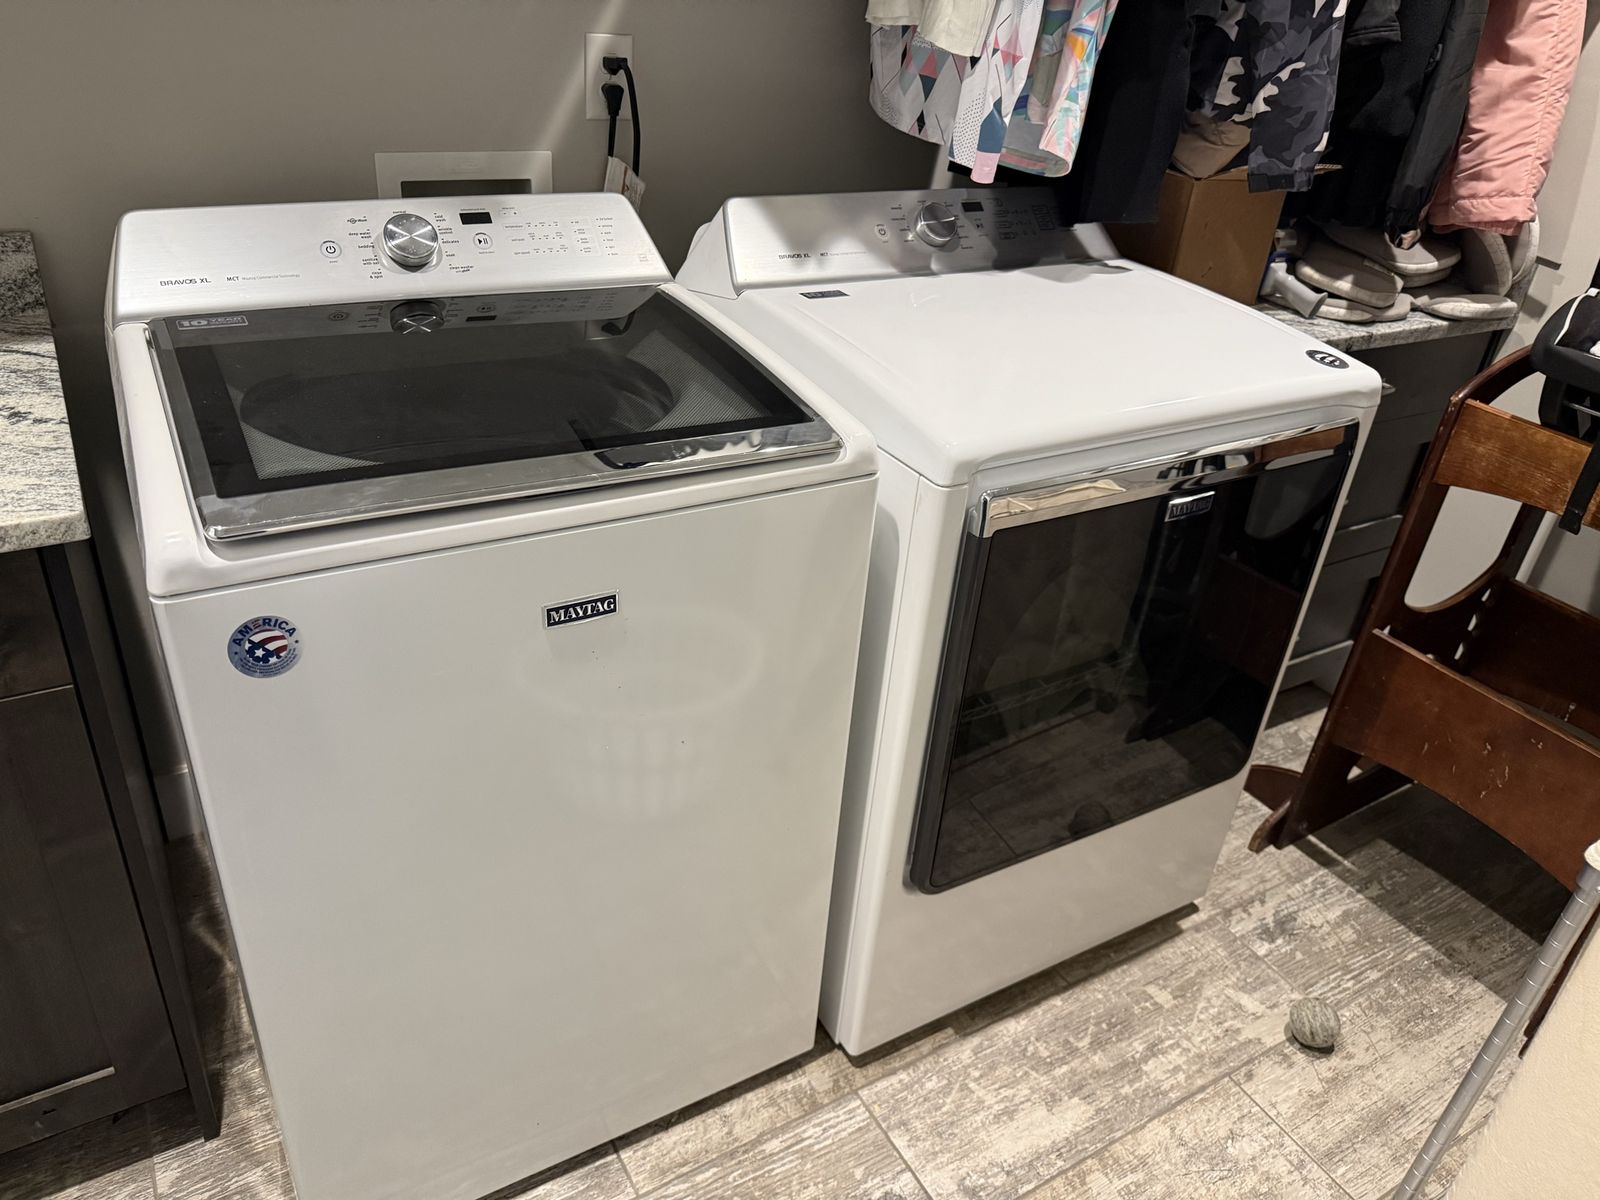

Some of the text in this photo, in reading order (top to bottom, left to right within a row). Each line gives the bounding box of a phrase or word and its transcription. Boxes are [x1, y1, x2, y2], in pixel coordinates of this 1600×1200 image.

[160, 278, 198, 287] BRAVOS
[181, 319, 208, 328] 10
[549, 598, 615, 624] MAYTAG
[231, 617, 297, 647] AMERICA
